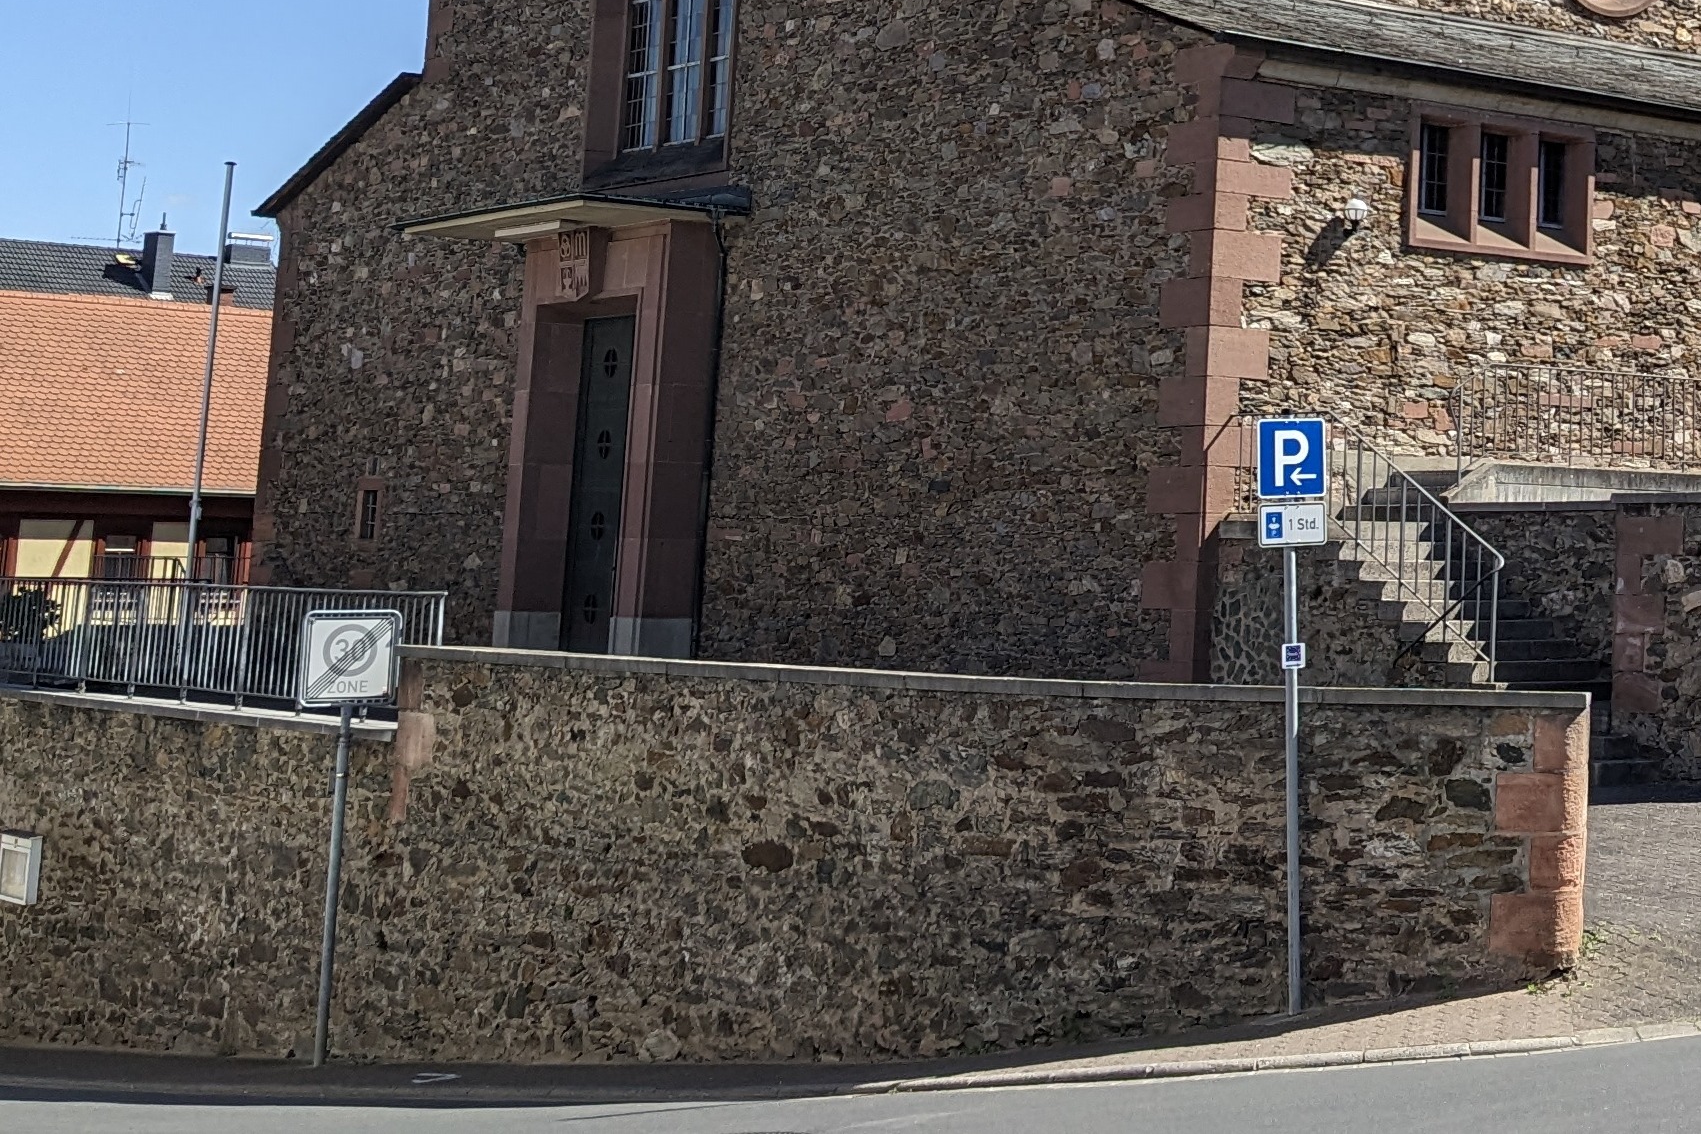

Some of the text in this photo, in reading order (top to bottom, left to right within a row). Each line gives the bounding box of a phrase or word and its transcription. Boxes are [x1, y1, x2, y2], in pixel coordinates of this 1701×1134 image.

[1274, 430, 1309, 487] P
[1288, 517, 1319, 530] 1 Std.
[327, 680, 368, 694] ZONE
